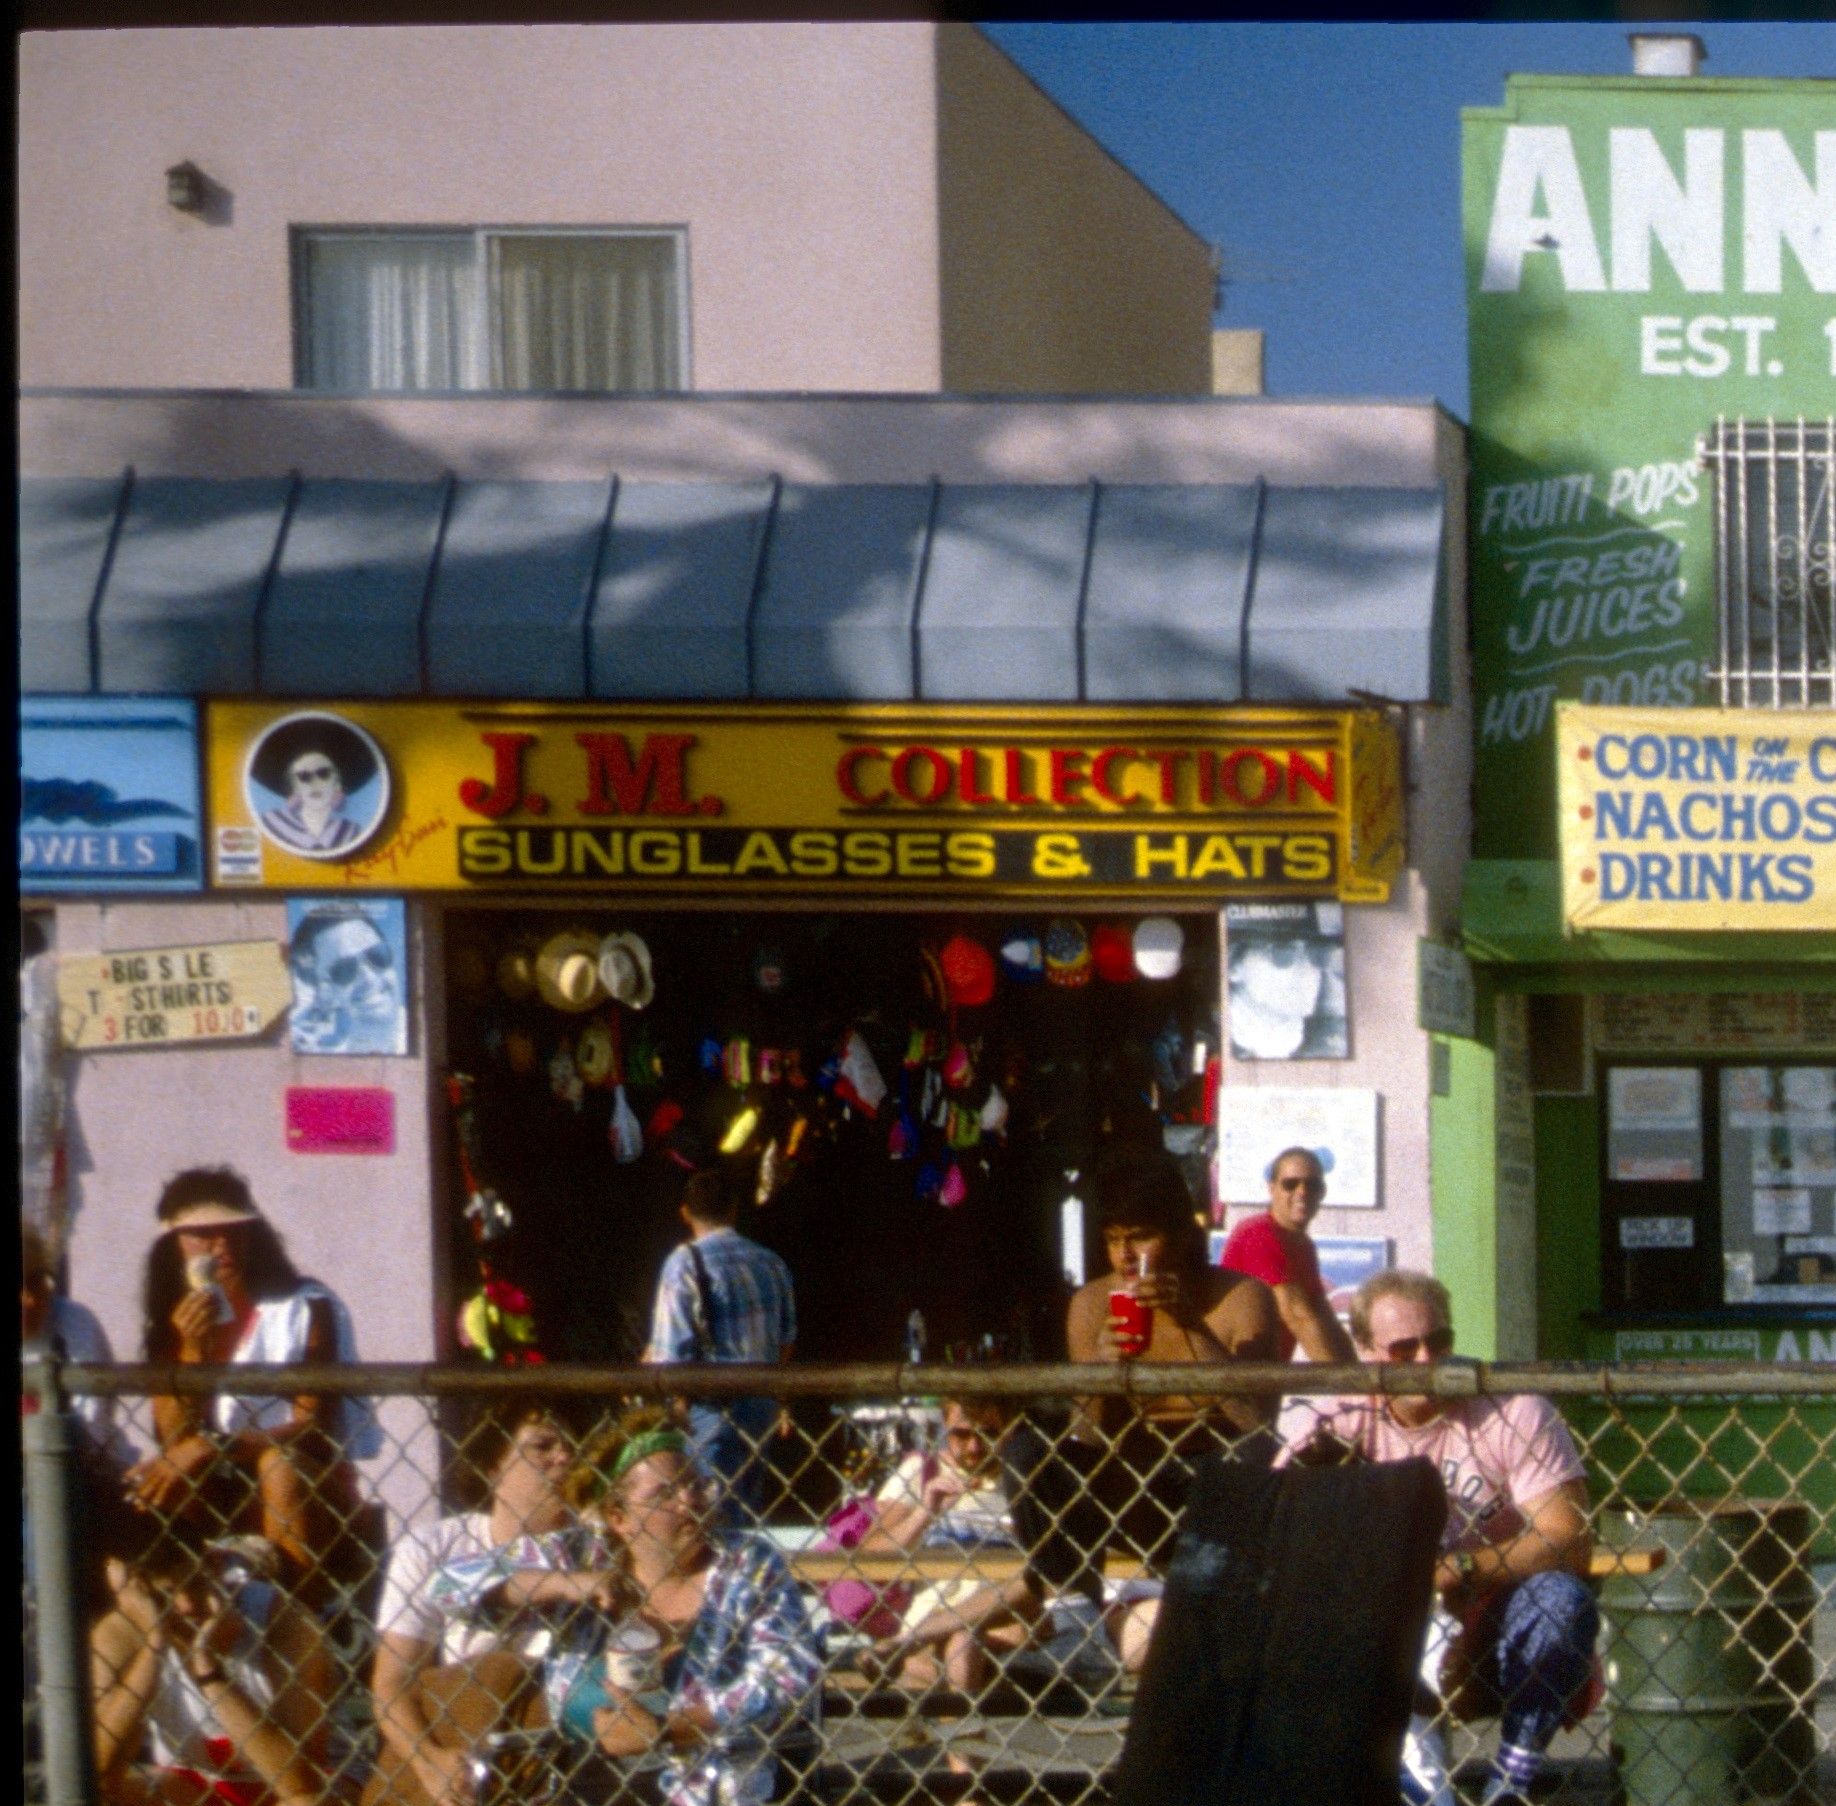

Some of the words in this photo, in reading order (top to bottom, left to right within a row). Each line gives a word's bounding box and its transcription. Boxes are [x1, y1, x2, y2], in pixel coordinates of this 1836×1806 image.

[1640, 315, 1784, 379] EST.
[1606, 459, 1700, 521] POPS
[1520, 539, 1686, 599] FRESH
[1507, 578, 1687, 656] JUICES
[1481, 684, 1558, 746] HOT
[1580, 662, 1700, 707] DOGS
[1594, 733, 1738, 781] CORN
[1745, 760, 1801, 784] THE
[1752, 736, 1789, 756] ON
[836, 745, 1337, 808] COLLECTION
[461, 829, 996, 879] SUNGLASSES
[1032, 833, 1091, 879] &
[1135, 834, 1331, 880] HATS
[1600, 852, 1815, 904] DRINKS
[112, 957, 149, 984] BIG
[123, 1014, 167, 1041] FOR
